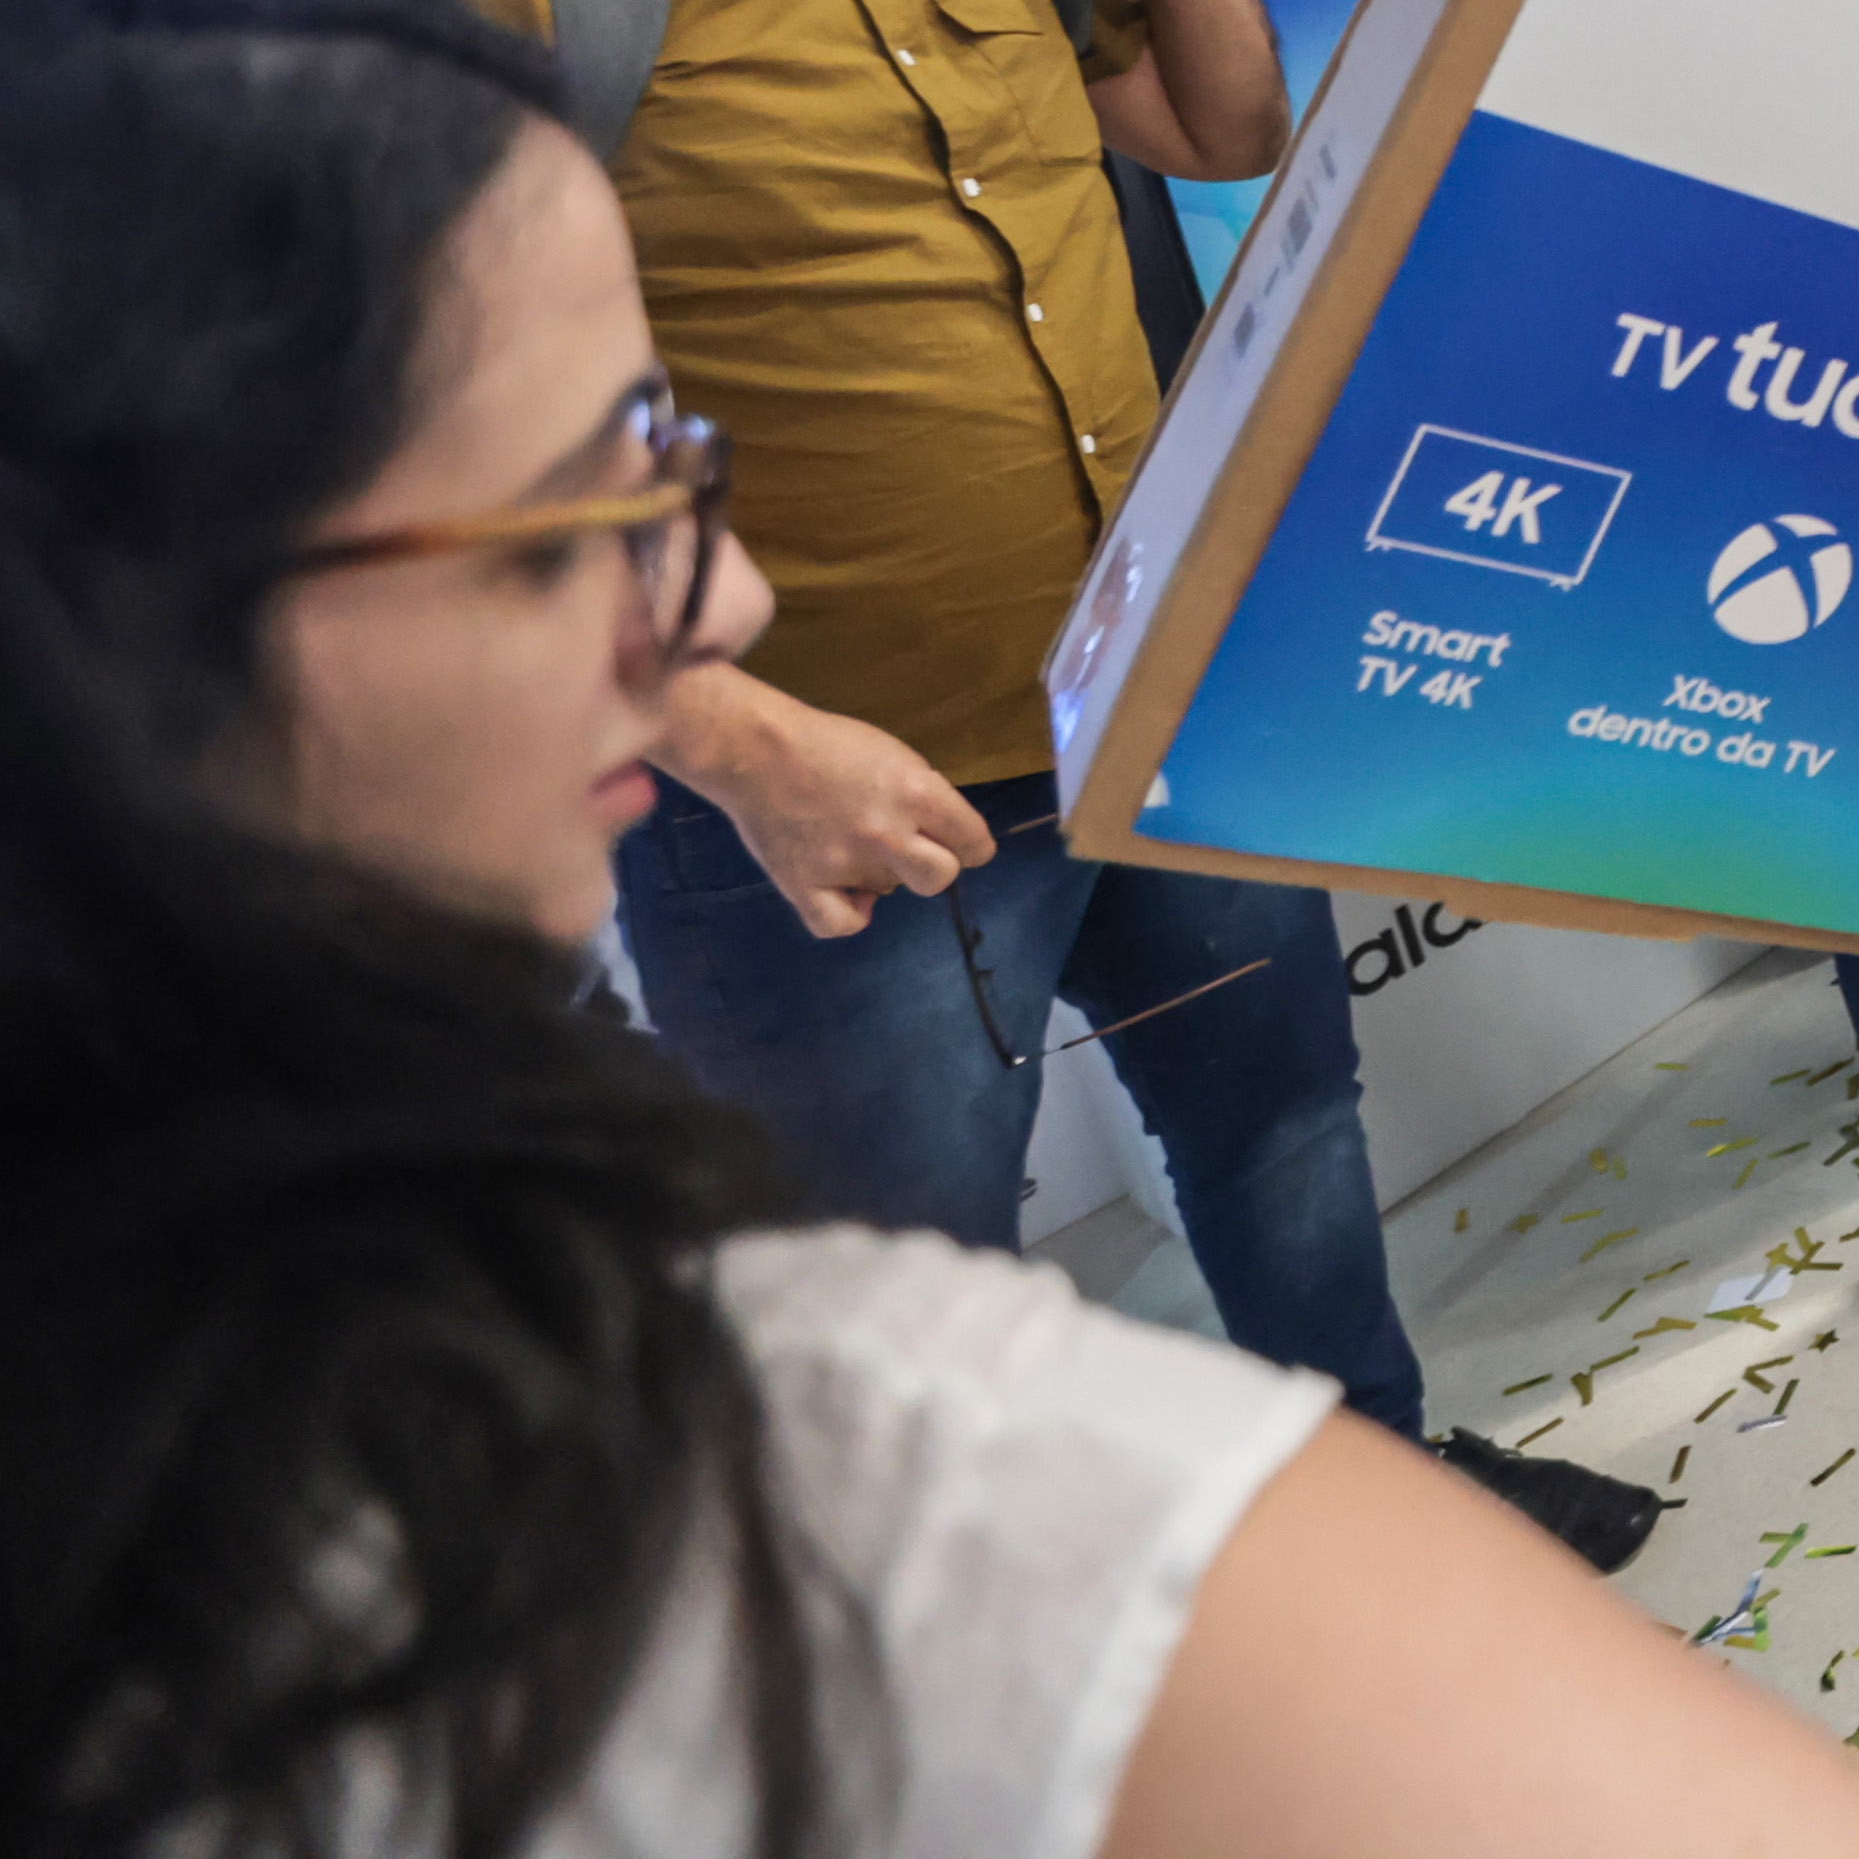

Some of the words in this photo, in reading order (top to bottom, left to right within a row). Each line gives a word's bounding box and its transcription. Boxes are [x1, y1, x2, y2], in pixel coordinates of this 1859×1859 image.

[1611, 313, 1718, 391] TV
[1444, 470, 1563, 544] 4K
[1363, 611, 1511, 668] Smart
[1357, 657, 1415, 698] TV
[1419, 667, 1482, 709] 4K
[1663, 675, 1771, 724] Xbox
[1568, 704, 1711, 762] dentro
[1717, 732, 1774, 770] da
[1783, 739, 1837, 779] TV
